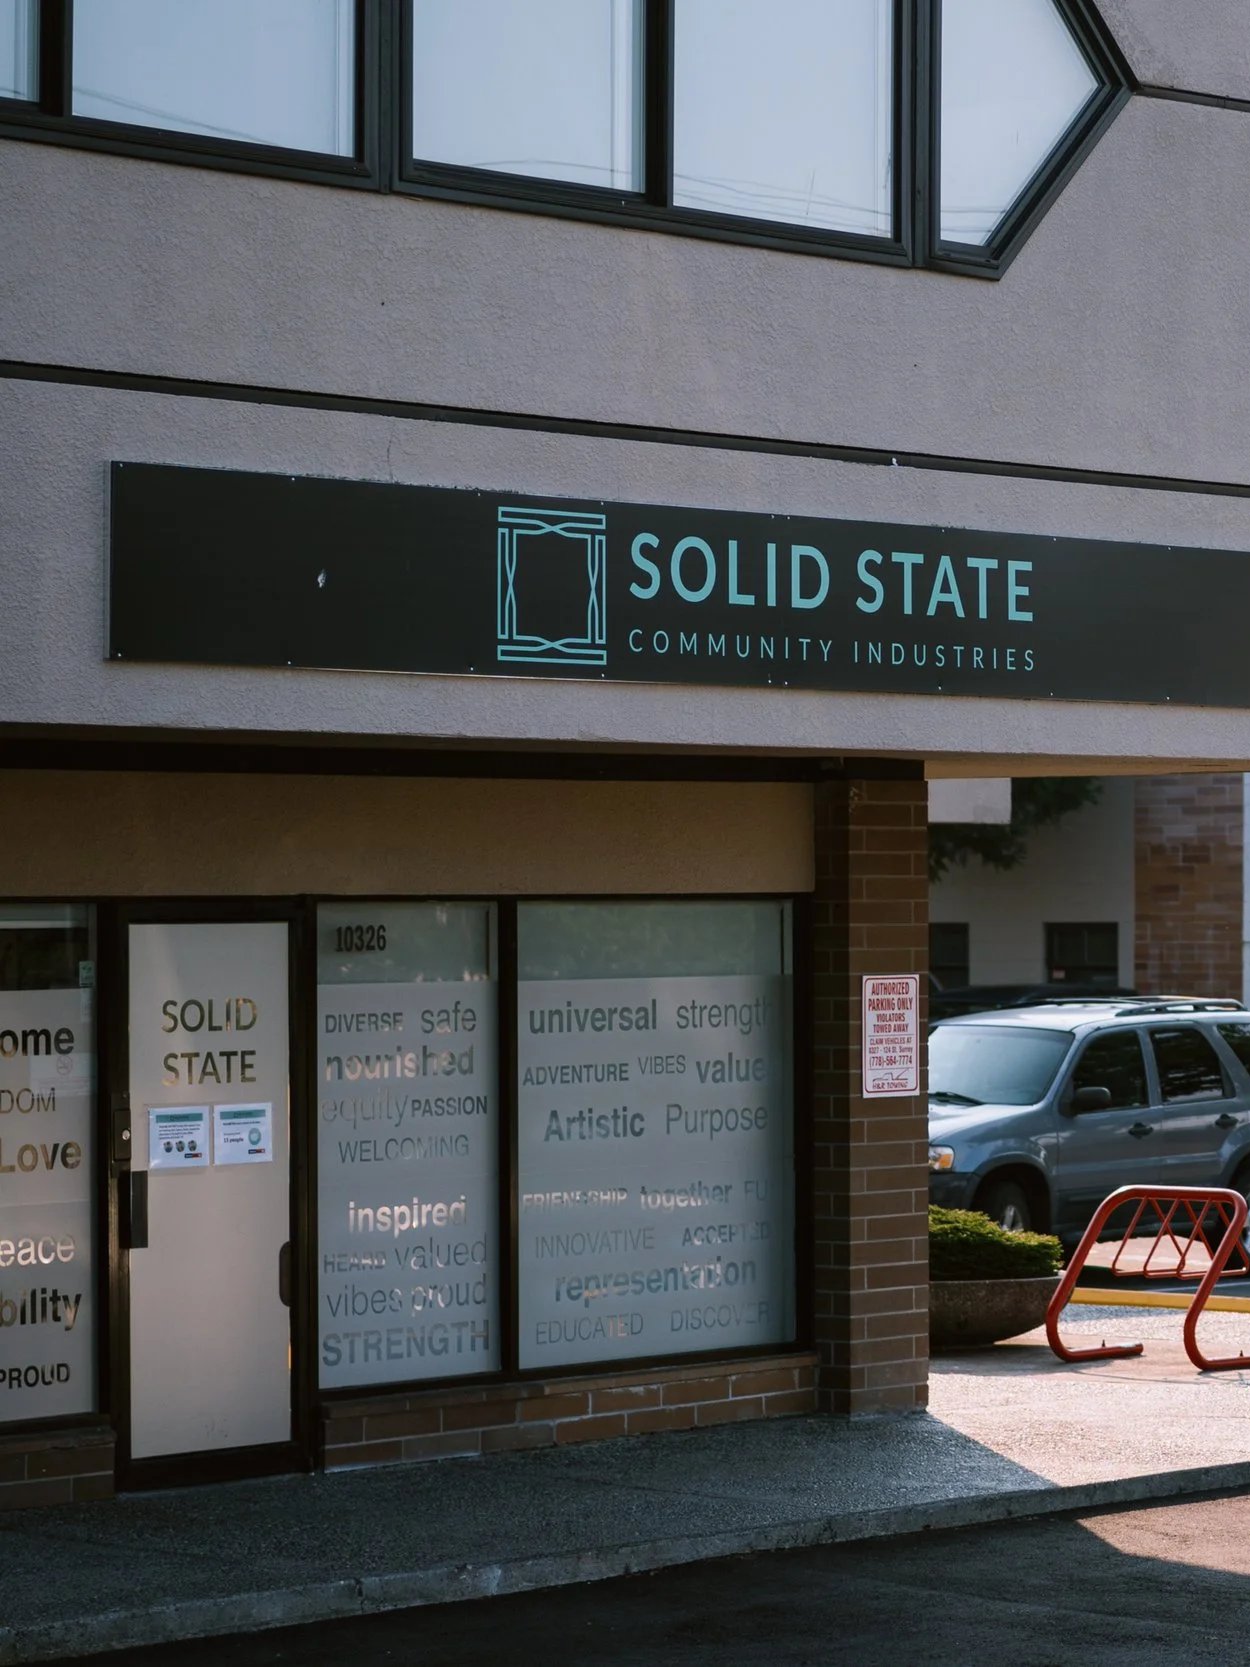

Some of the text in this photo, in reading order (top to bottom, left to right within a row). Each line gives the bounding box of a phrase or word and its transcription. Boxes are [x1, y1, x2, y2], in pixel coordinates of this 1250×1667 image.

[629, 532, 1034, 623] SOLID STATE
[628, 628, 1036, 671] COMMUNITY INDUSTRIES
[335, 924, 387, 953] 10326
[868, 997, 913, 1011] PARKING ONLY
[871, 982, 910, 996] AUTHORIZED
[161, 999, 258, 1034] SOLID
[325, 1000, 477, 1034] DIVERSE safe
[529, 999, 657, 1034] universal
[873, 1023, 909, 1034] TOWED AWAY
[876, 1013, 906, 1023] VIOLATORS
[870, 1038, 884, 1046] CLAIM
[884, 1037, 905, 1045] VEHICLES
[161, 1050, 257, 1087] STATE
[325, 1045, 475, 1082] nourished
[522, 1062, 630, 1086] ADVENTURE
[637, 1054, 687, 1076] VIBES
[887, 1081, 909, 1090] TOWING
[321, 1089, 488, 1130] equity PASSION
[543, 1104, 769, 1142] Artistic Purpose
[0, 1138, 82, 1173] Love
[338, 1134, 470, 1164] WELCOMING
[640, 1180, 733, 1212] together
[348, 1194, 467, 1238] inspired
[323, 1232, 488, 1274] HEARD valued
[535, 1227, 655, 1258] INNOVATIVE
[326, 1272, 488, 1318] vibes proud
[554, 1255, 756, 1309] representation
[322, 1319, 490, 1367] STRENGTH
[535, 1312, 644, 1345] EDUCATED
